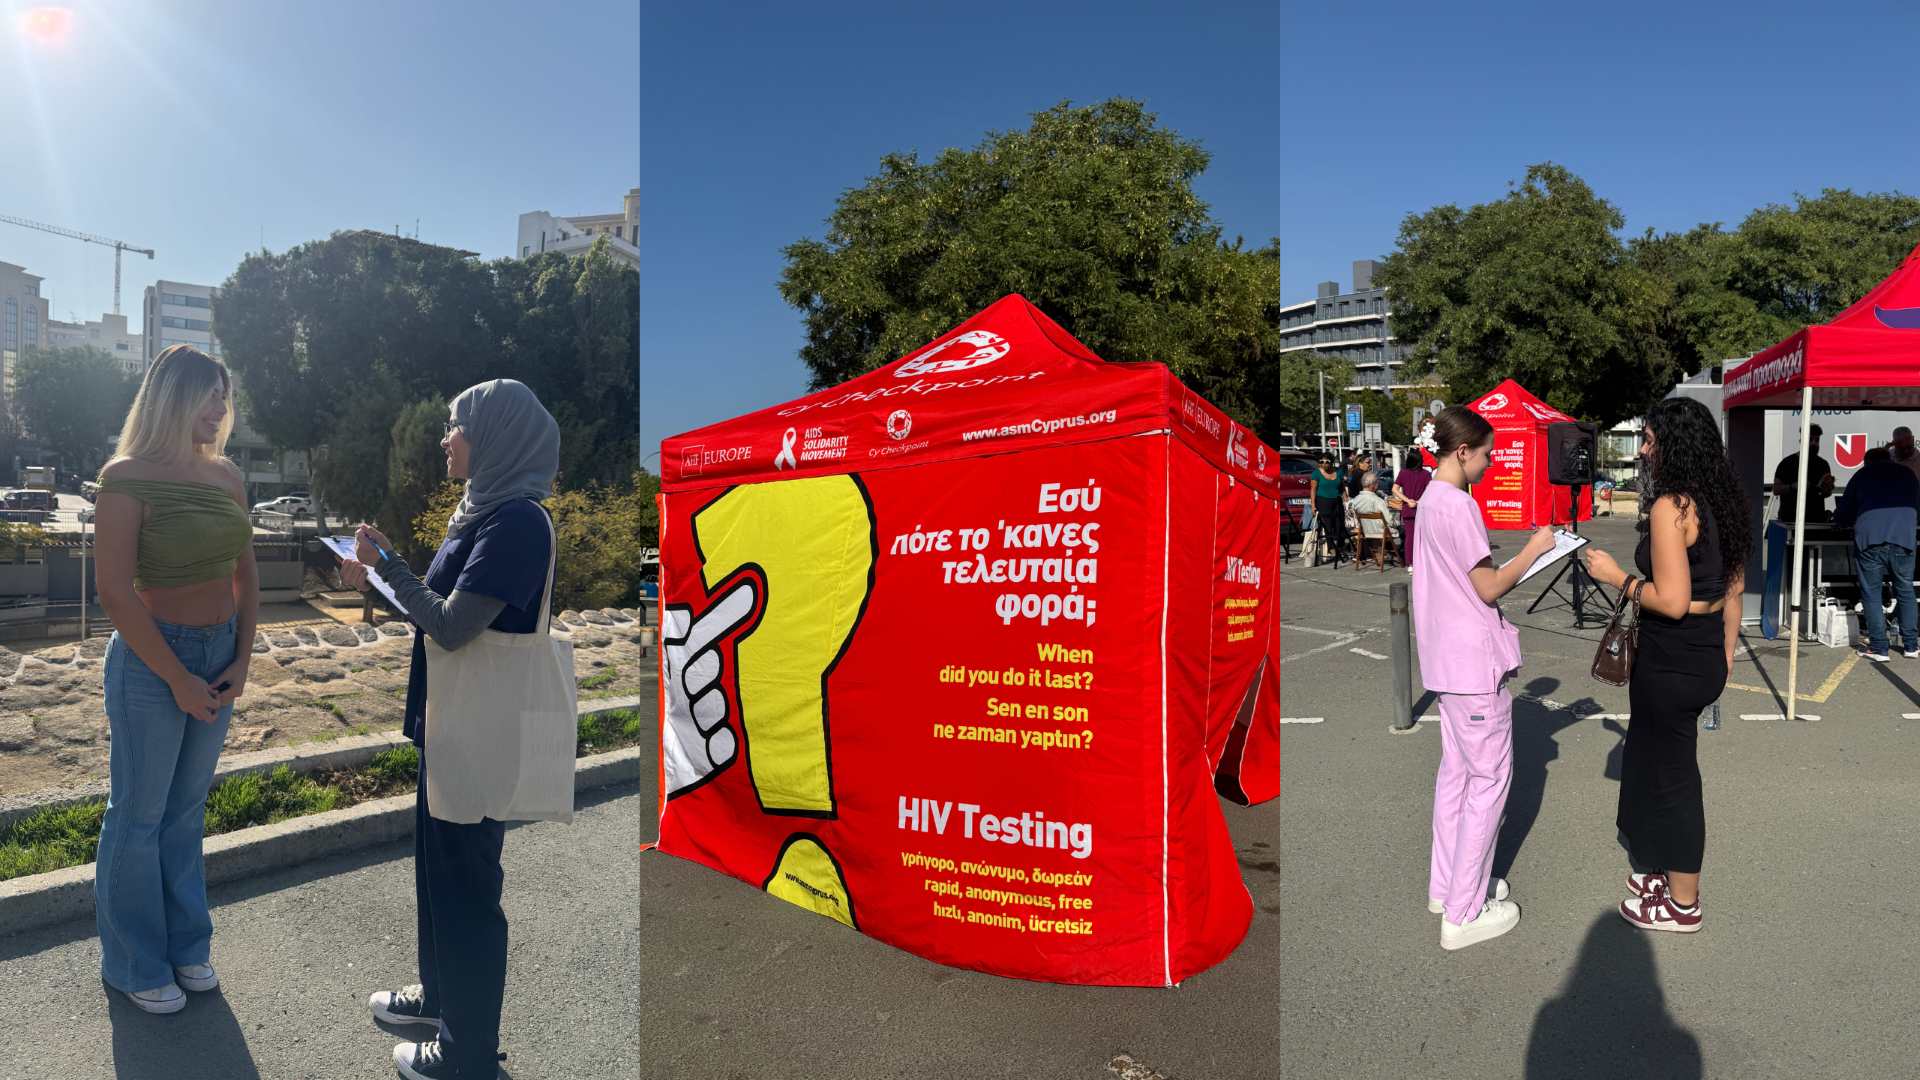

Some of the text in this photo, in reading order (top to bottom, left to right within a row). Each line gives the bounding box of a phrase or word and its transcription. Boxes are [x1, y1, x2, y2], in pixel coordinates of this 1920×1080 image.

[1752, 340, 1803, 393] προσφορά
[777, 371, 1046, 417] Cy Checkpoint
[805, 427, 822, 439] AIDS
[962, 409, 1117, 441] www.asmCyprus.org
[684, 446, 752, 467] AHF EUROPE
[800, 448, 847, 461] MOVEMENT
[803, 436, 849, 450] SOLIDARITY
[868, 440, 929, 458] Cy Checkpoint
[1038, 478, 1101, 513] Εσύ
[1497, 500, 1522, 509] Testing
[958, 528, 990, 551] το
[942, 549, 1098, 584] τελευταία
[1237, 559, 1261, 590] Testing
[995, 585, 1096, 628] φορά;
[1037, 643, 1093, 664] When
[939, 665, 1094, 690] did you do it last?
[986, 697, 1088, 722] Sen en son
[933, 723, 1094, 751] ne zaman yaptın?
[898, 795, 1092, 859] HIV Testing
[901, 851, 1093, 887] γρήγορο, ανώνυμο, δωρεάν
[924, 879, 1093, 911] rapid, anonymous, free
[933, 901, 1093, 934] hızlı, anonim, ücretsiz
